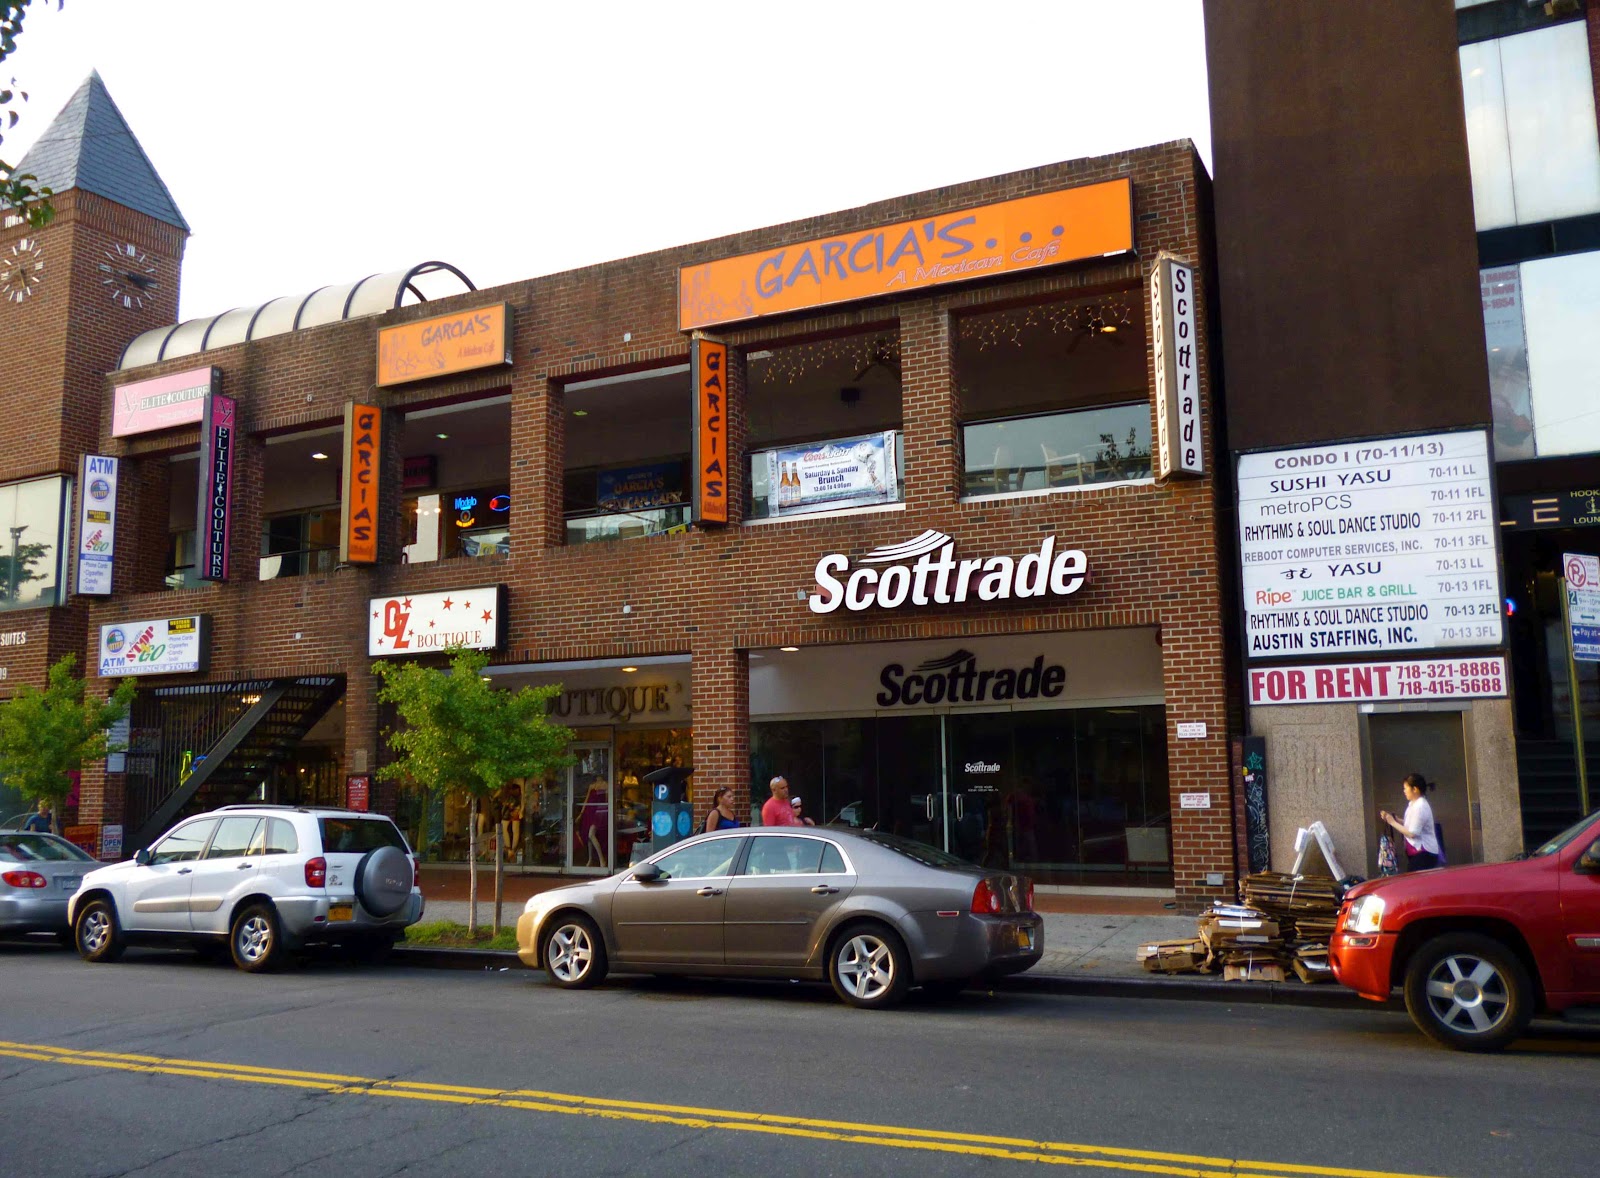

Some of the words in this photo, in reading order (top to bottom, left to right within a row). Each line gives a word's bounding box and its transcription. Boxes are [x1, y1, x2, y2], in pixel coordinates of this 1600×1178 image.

[886, 270, 906, 286] A
[914, 256, 1002, 282] Mexican
[420, 314, 491, 348] GARCIA'S
[1152, 271, 1168, 470] Scottrade
[1174, 268, 1196, 466] Scottrade
[141, 394, 167, 410] ELITE
[705, 352, 723, 498] GARCIAS
[216, 427, 227, 485] ELITE
[1274, 452, 1338, 470] CONDO
[1356, 442, 1444, 464] (70-11/13)
[89, 458, 114, 474] ATM
[805, 470, 830, 479] Saturday
[837, 465, 859, 474] Sunday
[1429, 466, 1460, 478] 70-11
[1462, 464, 1476, 476] LL
[354, 414, 375, 542] GARCIAS
[818, 474, 844, 484] Brunch
[1270, 476, 1326, 493] SUSHI
[1338, 469, 1392, 486] YASU
[1431, 488, 1461, 501] 70-11
[1464, 486, 1486, 498] 1FL
[1570, 490, 1600, 498] HOOK
[454, 496, 477, 510] Modelo
[1260, 494, 1352, 516] metroPCS
[1432, 511, 1463, 524] 70-11
[1466, 509, 1486, 521] 2FL
[1245, 522, 1294, 542] RHYTHMS
[1297, 522, 1304, 537] &
[1308, 518, 1335, 537] SOUL
[1339, 515, 1376, 534] DANCE
[1380, 512, 1421, 530] STUDIO
[85, 530, 102, 550] STOP
[212, 496, 225, 578] COUTURE
[1434, 536, 1465, 549] 70-11
[1468, 535, 1488, 546] 3FL
[1244, 550, 1284, 562] REBOOT
[1286, 546, 1342, 559] COMPUTER
[1345, 542, 1398, 556] SERVICES,
[1401, 539, 1423, 551] INC.
[1328, 561, 1382, 577] YASU
[1436, 558, 1467, 571] 70-13
[1470, 557, 1483, 568] LL
[808, 534, 1088, 614] Scottrade
[1301, 588, 1334, 602] JUICE
[1337, 586, 1363, 600] BAR
[1367, 586, 1376, 597] &
[1380, 584, 1417, 597] GRILL
[1438, 581, 1469, 593] 70-13
[1472, 579, 1493, 591] 1FL
[1256, 587, 1292, 606] Ripe
[1251, 611, 1300, 630] RHYTHMS
[1303, 611, 1311, 626] &
[1314, 608, 1342, 625] SOUL
[1346, 607, 1384, 624] DANCE
[1387, 604, 1428, 622] STUDIO
[1444, 604, 1475, 617] 70-13
[1479, 603, 1499, 614] 2FL
[0, 631, 26, 646] SUITES
[417, 630, 482, 648] BOUTIQUE
[1253, 632, 1304, 651] AUSTIN
[1310, 628, 1382, 648] STAFFING,
[1388, 627, 1418, 643] INC.
[1442, 627, 1472, 639] 70-13
[1476, 626, 1496, 637] 3FL
[1581, 628, 1590, 637] Pay
[126, 626, 154, 662] STOP
[139, 644, 165, 662] GO
[102, 664, 164, 675] CONVENIENCE
[166, 662, 194, 671] STORE
[103, 657, 125, 667] ATM
[1396, 661, 1500, 679] 718-321-8886
[876, 654, 1066, 707] Scottrade
[1251, 670, 1306, 701] FOR
[1315, 666, 1391, 699] RENT
[1397, 678, 1501, 695] 718-415-5688
[545, 685, 670, 721] UTIQUE
[964, 762, 1000, 772] Scottrade
[658, 784, 667, 799] P
